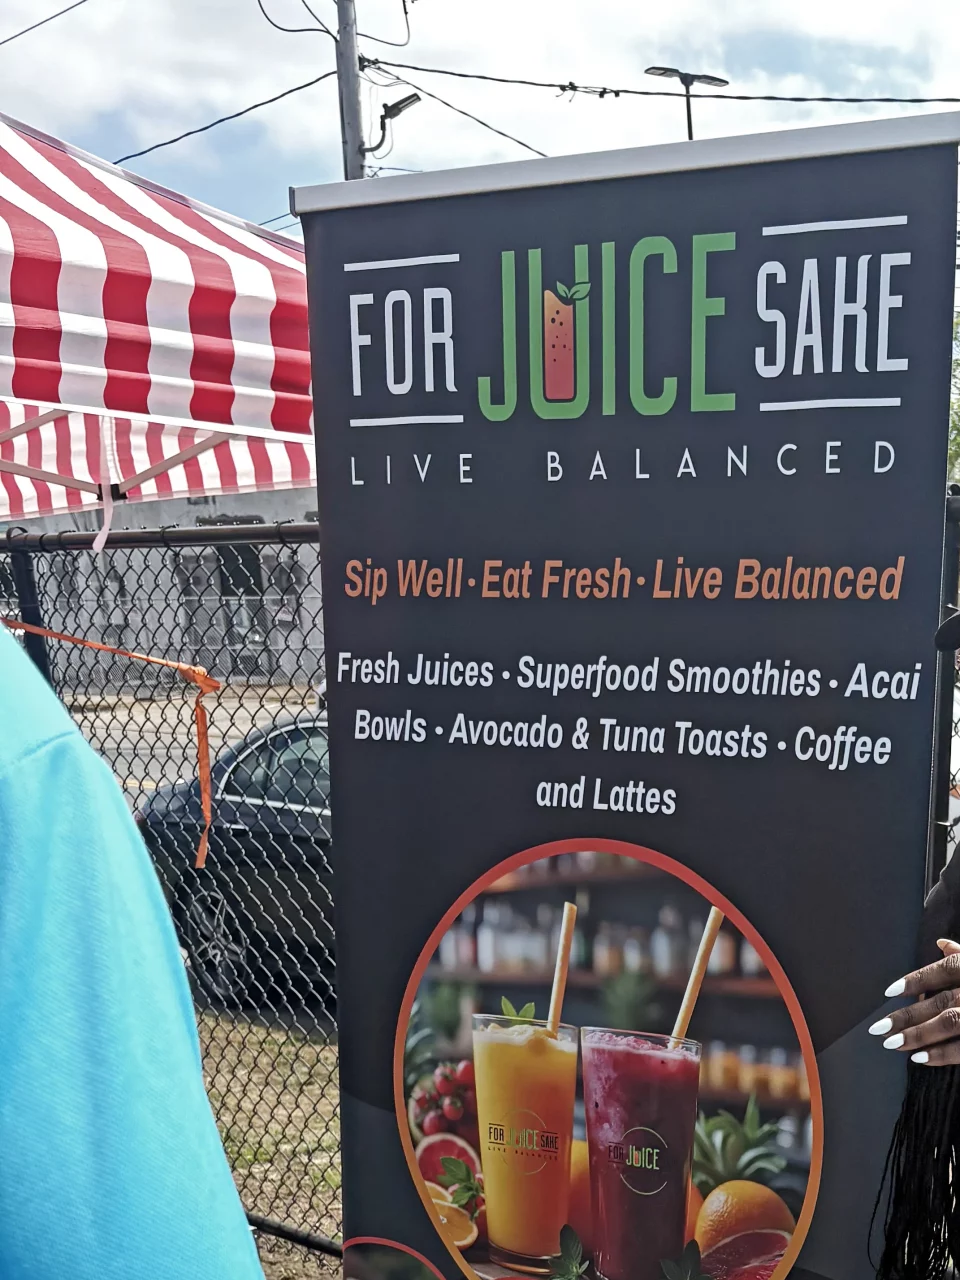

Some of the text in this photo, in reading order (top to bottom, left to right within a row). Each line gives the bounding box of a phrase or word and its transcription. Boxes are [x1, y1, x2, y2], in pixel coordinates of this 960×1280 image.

[349, 231, 912, 421] FOR JUICE SAKE
[351, 440, 896, 486] LIVE BALANCED
[344, 555, 906, 605] Sip Well Eat Fresh Live Balanced
[336, 651, 922, 701] Fresh Juices Superfood Smoothies Acai
[354, 708, 893, 771] Bowls Avocado & Tuna Toasts Coffee
[535, 777, 678, 817] and Lattes
[488, 1126, 559, 1151] FOR JUICE SAKE
[608, 1145, 660, 1170] FOR JUICE
